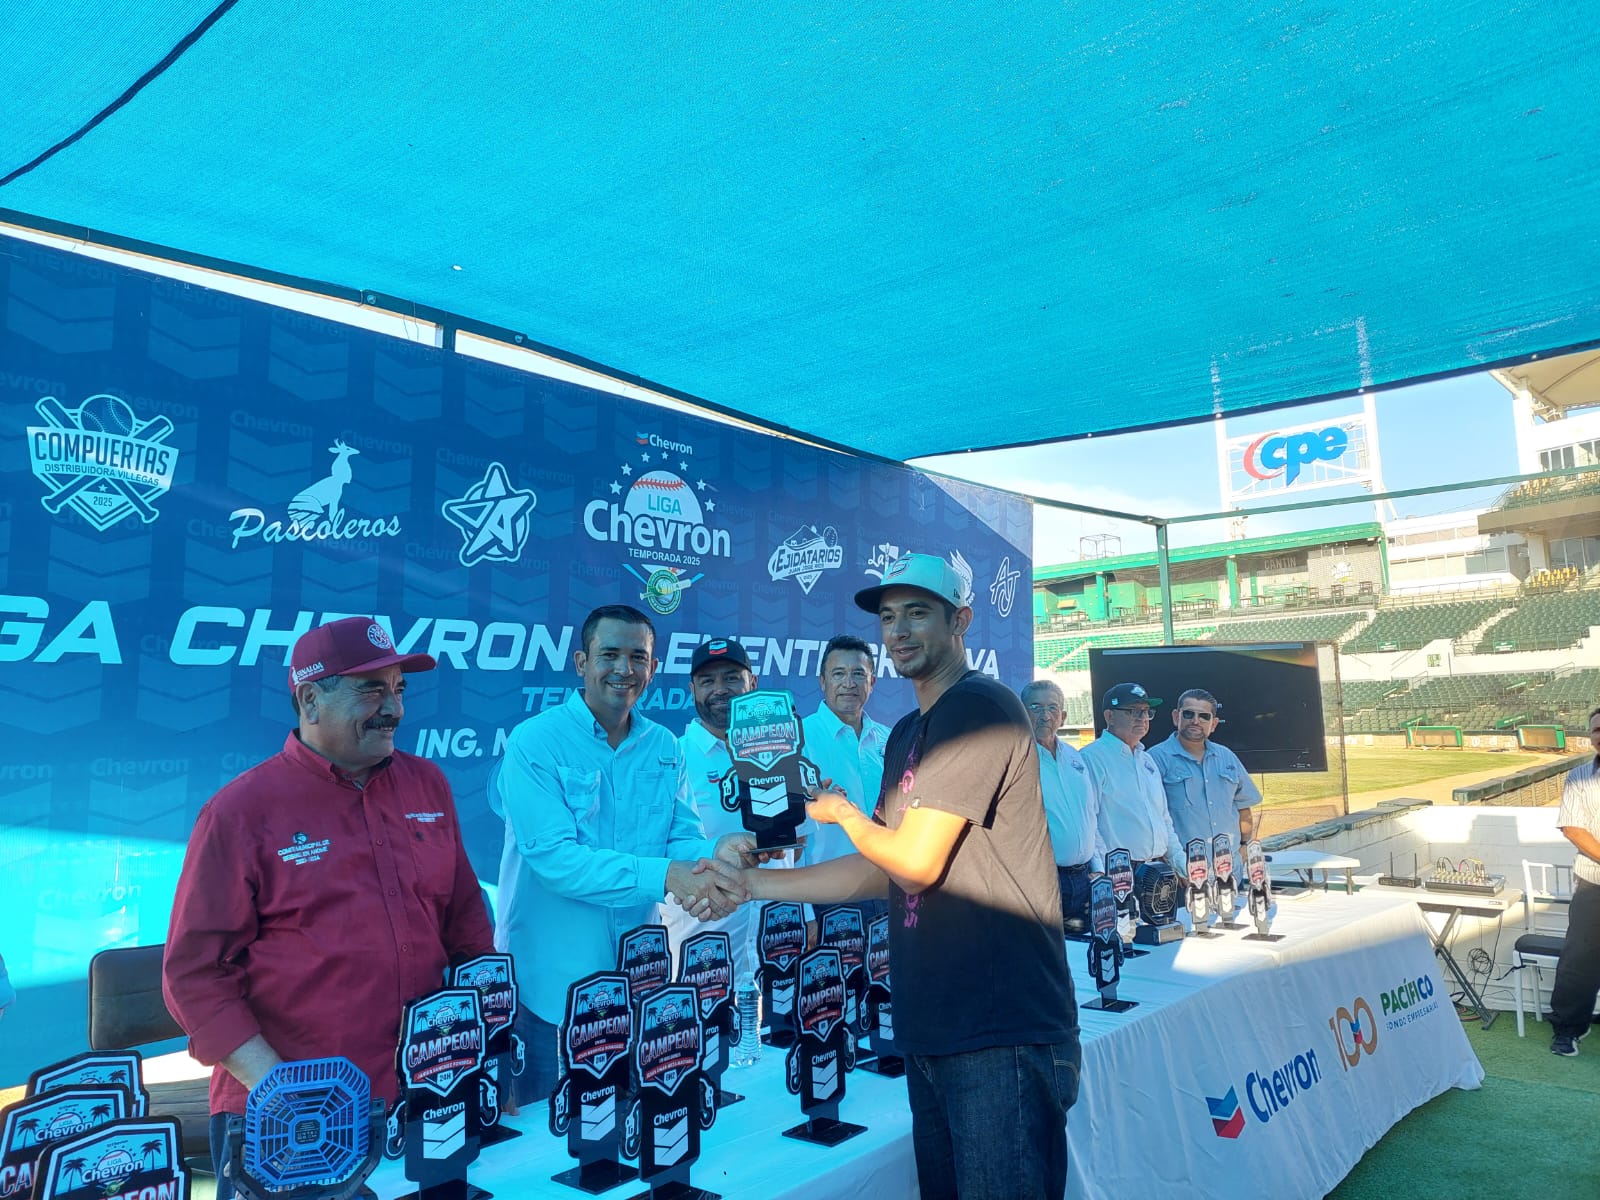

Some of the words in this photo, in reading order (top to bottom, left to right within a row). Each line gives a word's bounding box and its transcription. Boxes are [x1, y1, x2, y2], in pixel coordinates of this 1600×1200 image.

[34, 431, 170, 476] COMPUERTAS
[649, 433, 694, 456] Chevron
[1260, 426, 1348, 487] cpe
[44, 463, 116, 477] DISTRIBUIDORA
[117, 470, 160, 487] VILLEGAS
[93, 495, 113, 507] 2025
[647, 493, 682, 516] LIGA
[228, 507, 402, 550] Pascoleros
[584, 500, 731, 558] Chevron
[628, 547, 682, 563] TEMPORADA
[682, 555, 701, 566] 2025
[775, 548, 841, 573] EJIDATARIOS
[169, 605, 574, 672] CHVRON
[415, 727, 482, 759] ING.
[732, 721, 796, 746] CAMPEON
[89, 757, 189, 777] Chevron
[748, 775, 786, 786] Chevron
[800, 983, 843, 1017] CAMPEON
[1380, 974, 1434, 1017] PACÍFICO
[427, 1013, 461, 1027] Chevron
[571, 1013, 630, 1048] CAMPEON
[408, 1028, 481, 1068] CAMPEON
[640, 1026, 699, 1066] CAMPEON
[811, 1049, 837, 1066] Chevron
[581, 1085, 616, 1104] Chevron
[1245, 1048, 1322, 1124] Chevron
[423, 1101, 466, 1121] Chevron
[653, 1106, 688, 1126] Chevron
[35, 1121, 93, 1141] Chevron
[82, 1159, 144, 1184] Chevron
